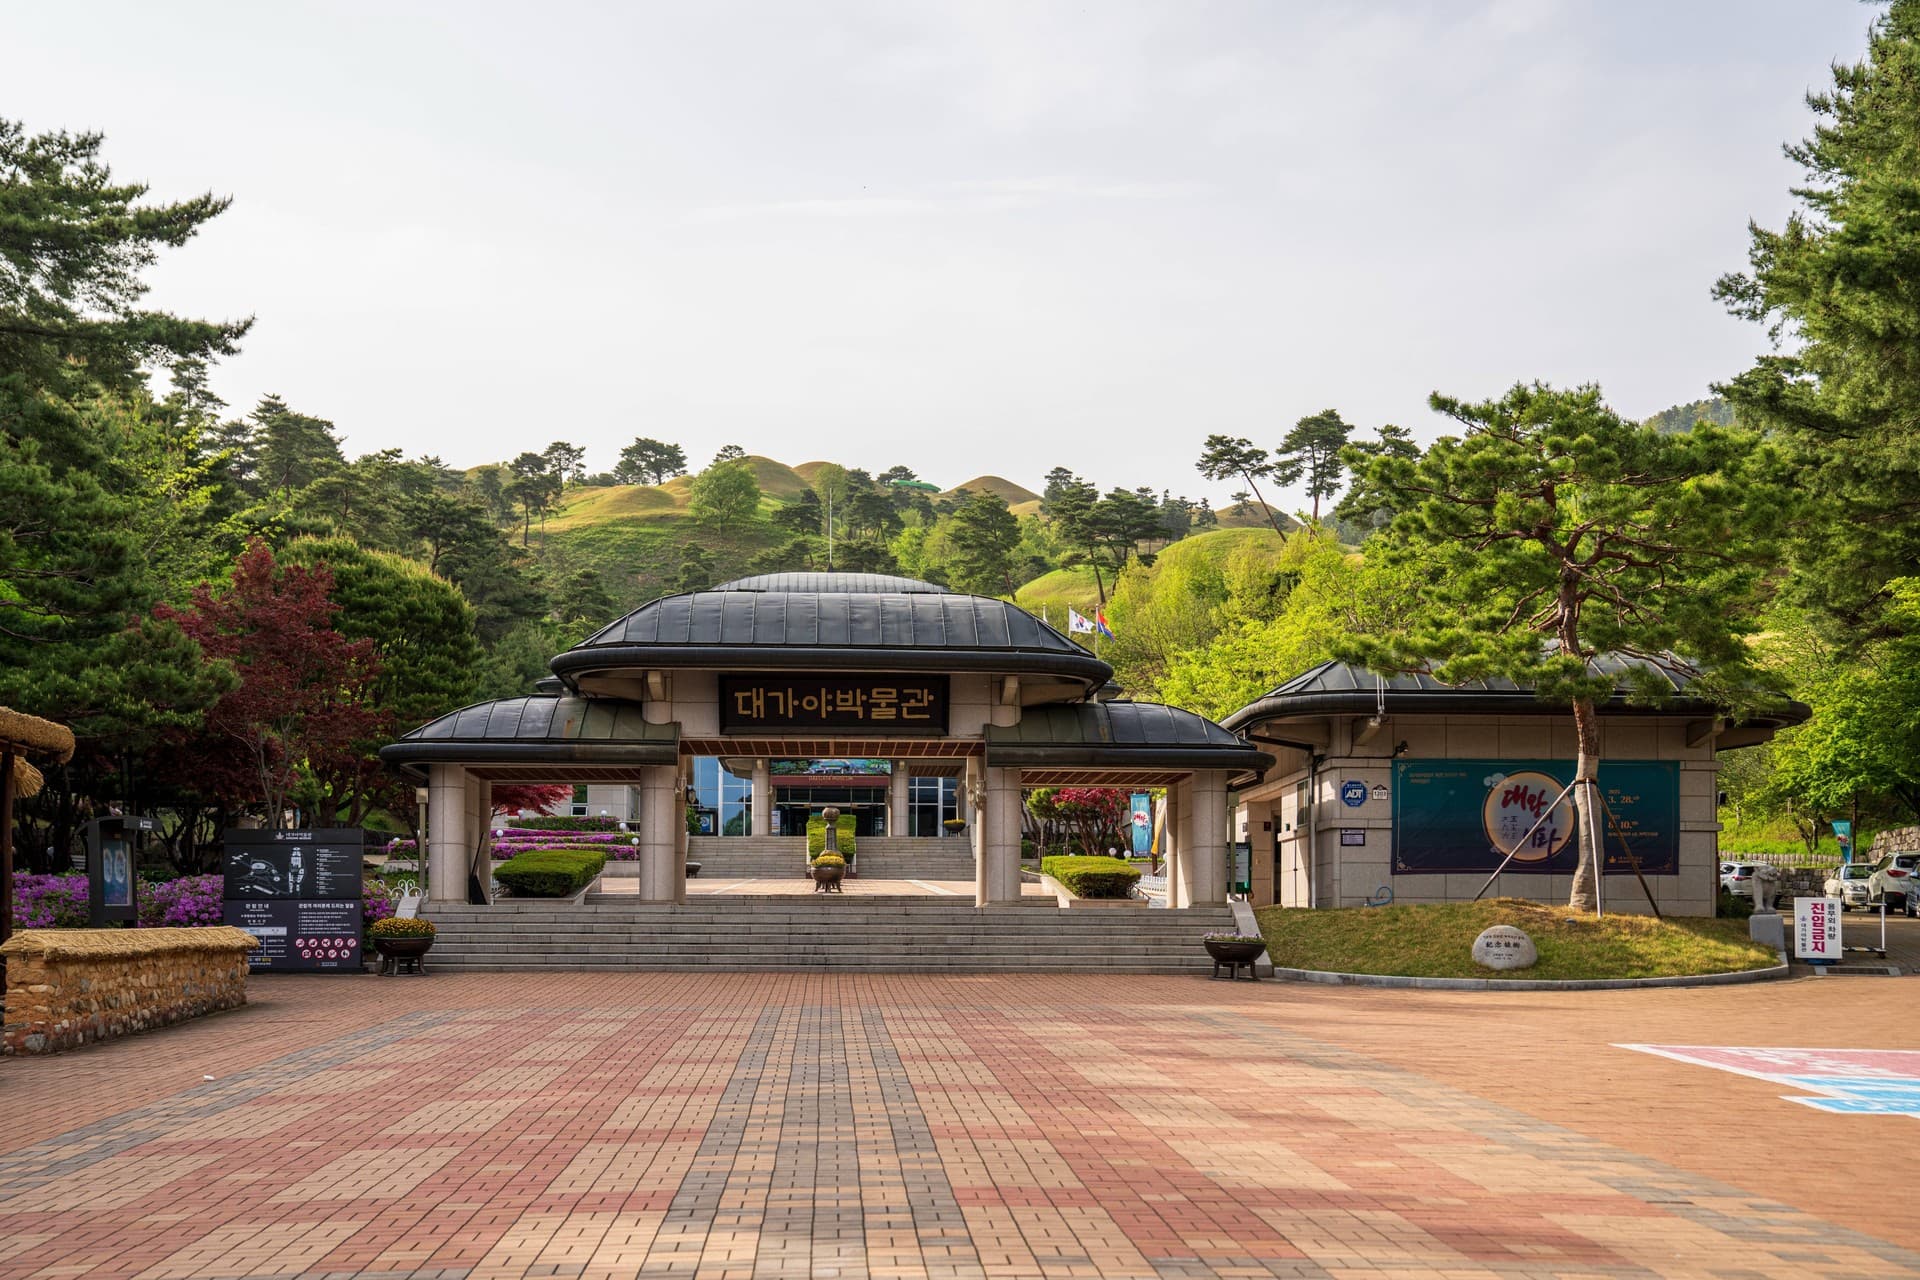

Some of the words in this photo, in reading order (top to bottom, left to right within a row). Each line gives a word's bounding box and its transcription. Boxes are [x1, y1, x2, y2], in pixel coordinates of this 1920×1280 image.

[734, 687, 934, 719] 대가야박물관
[1346, 789, 1363, 799] ADT
[1811, 903, 1825, 953] 진입금지
